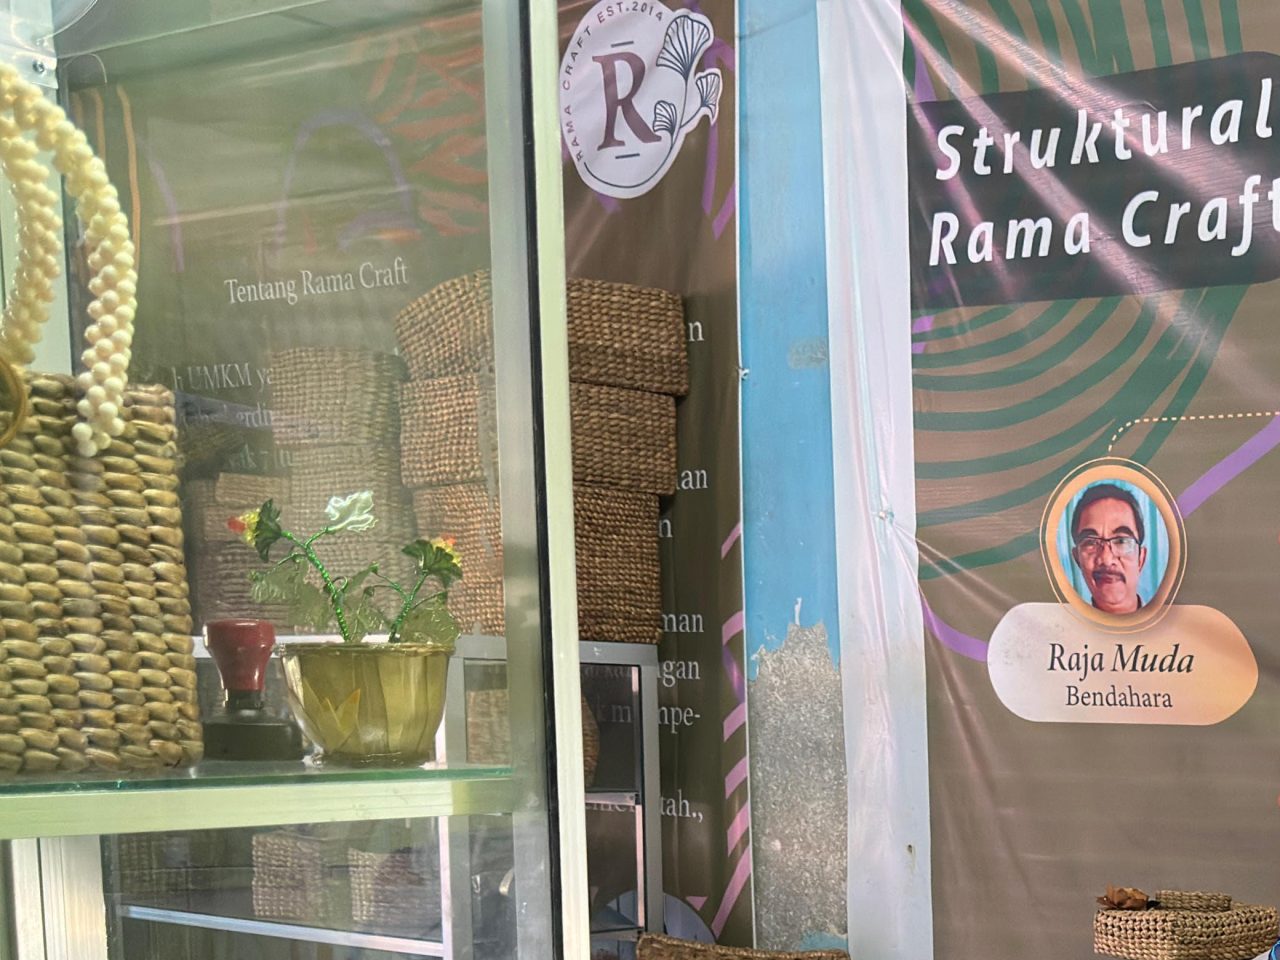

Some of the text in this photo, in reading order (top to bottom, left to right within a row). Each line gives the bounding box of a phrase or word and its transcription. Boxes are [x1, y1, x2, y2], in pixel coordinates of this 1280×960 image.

[935, 77, 1274, 180] Struktural
[928, 211, 1091, 266] Rama
[223, 255, 409, 306] Tentang Rama Craft
[187, 362, 252, 394] UMKM
[1046, 642, 1195, 682] Raja Muda
[1065, 685, 1173, 708] Bendahara
